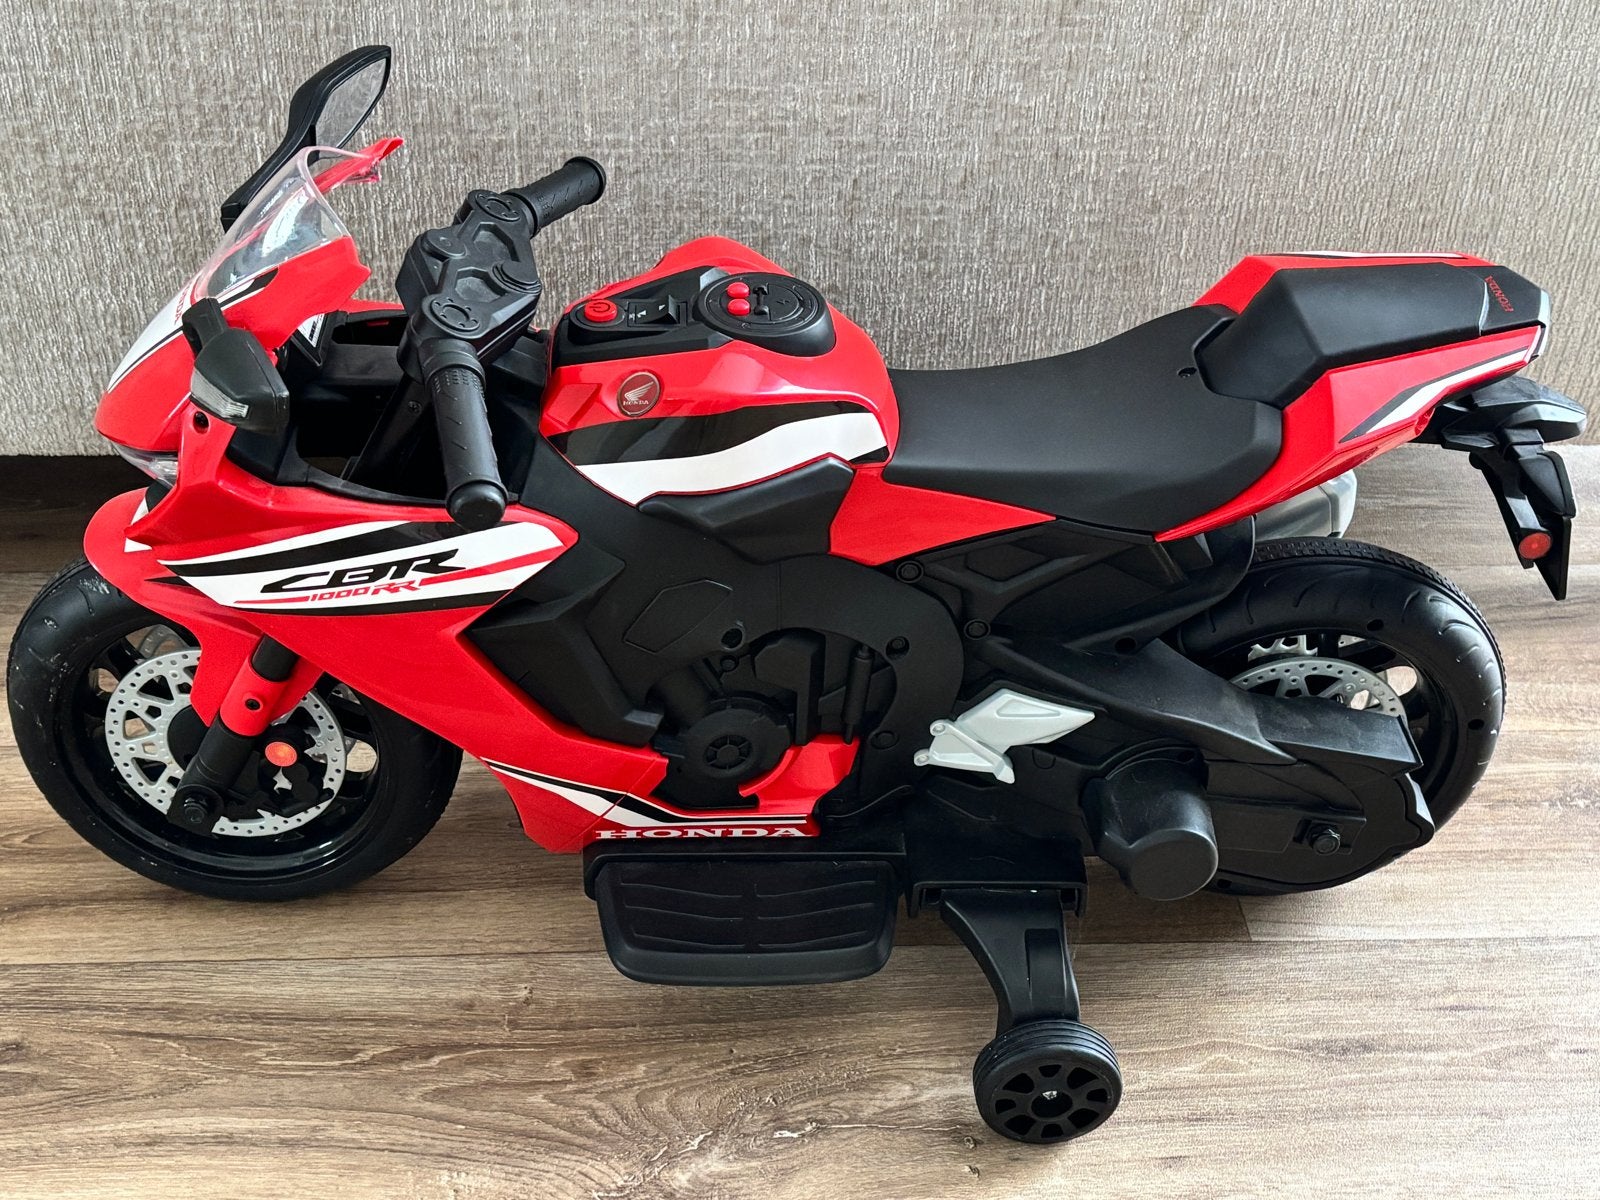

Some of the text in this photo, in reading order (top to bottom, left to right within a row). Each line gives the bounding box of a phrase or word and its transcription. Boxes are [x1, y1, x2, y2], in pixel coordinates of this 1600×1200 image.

[1485, 275, 1514, 312] HONDA
[260, 548, 466, 593] CBR
[595, 827, 814, 839] HONDA
